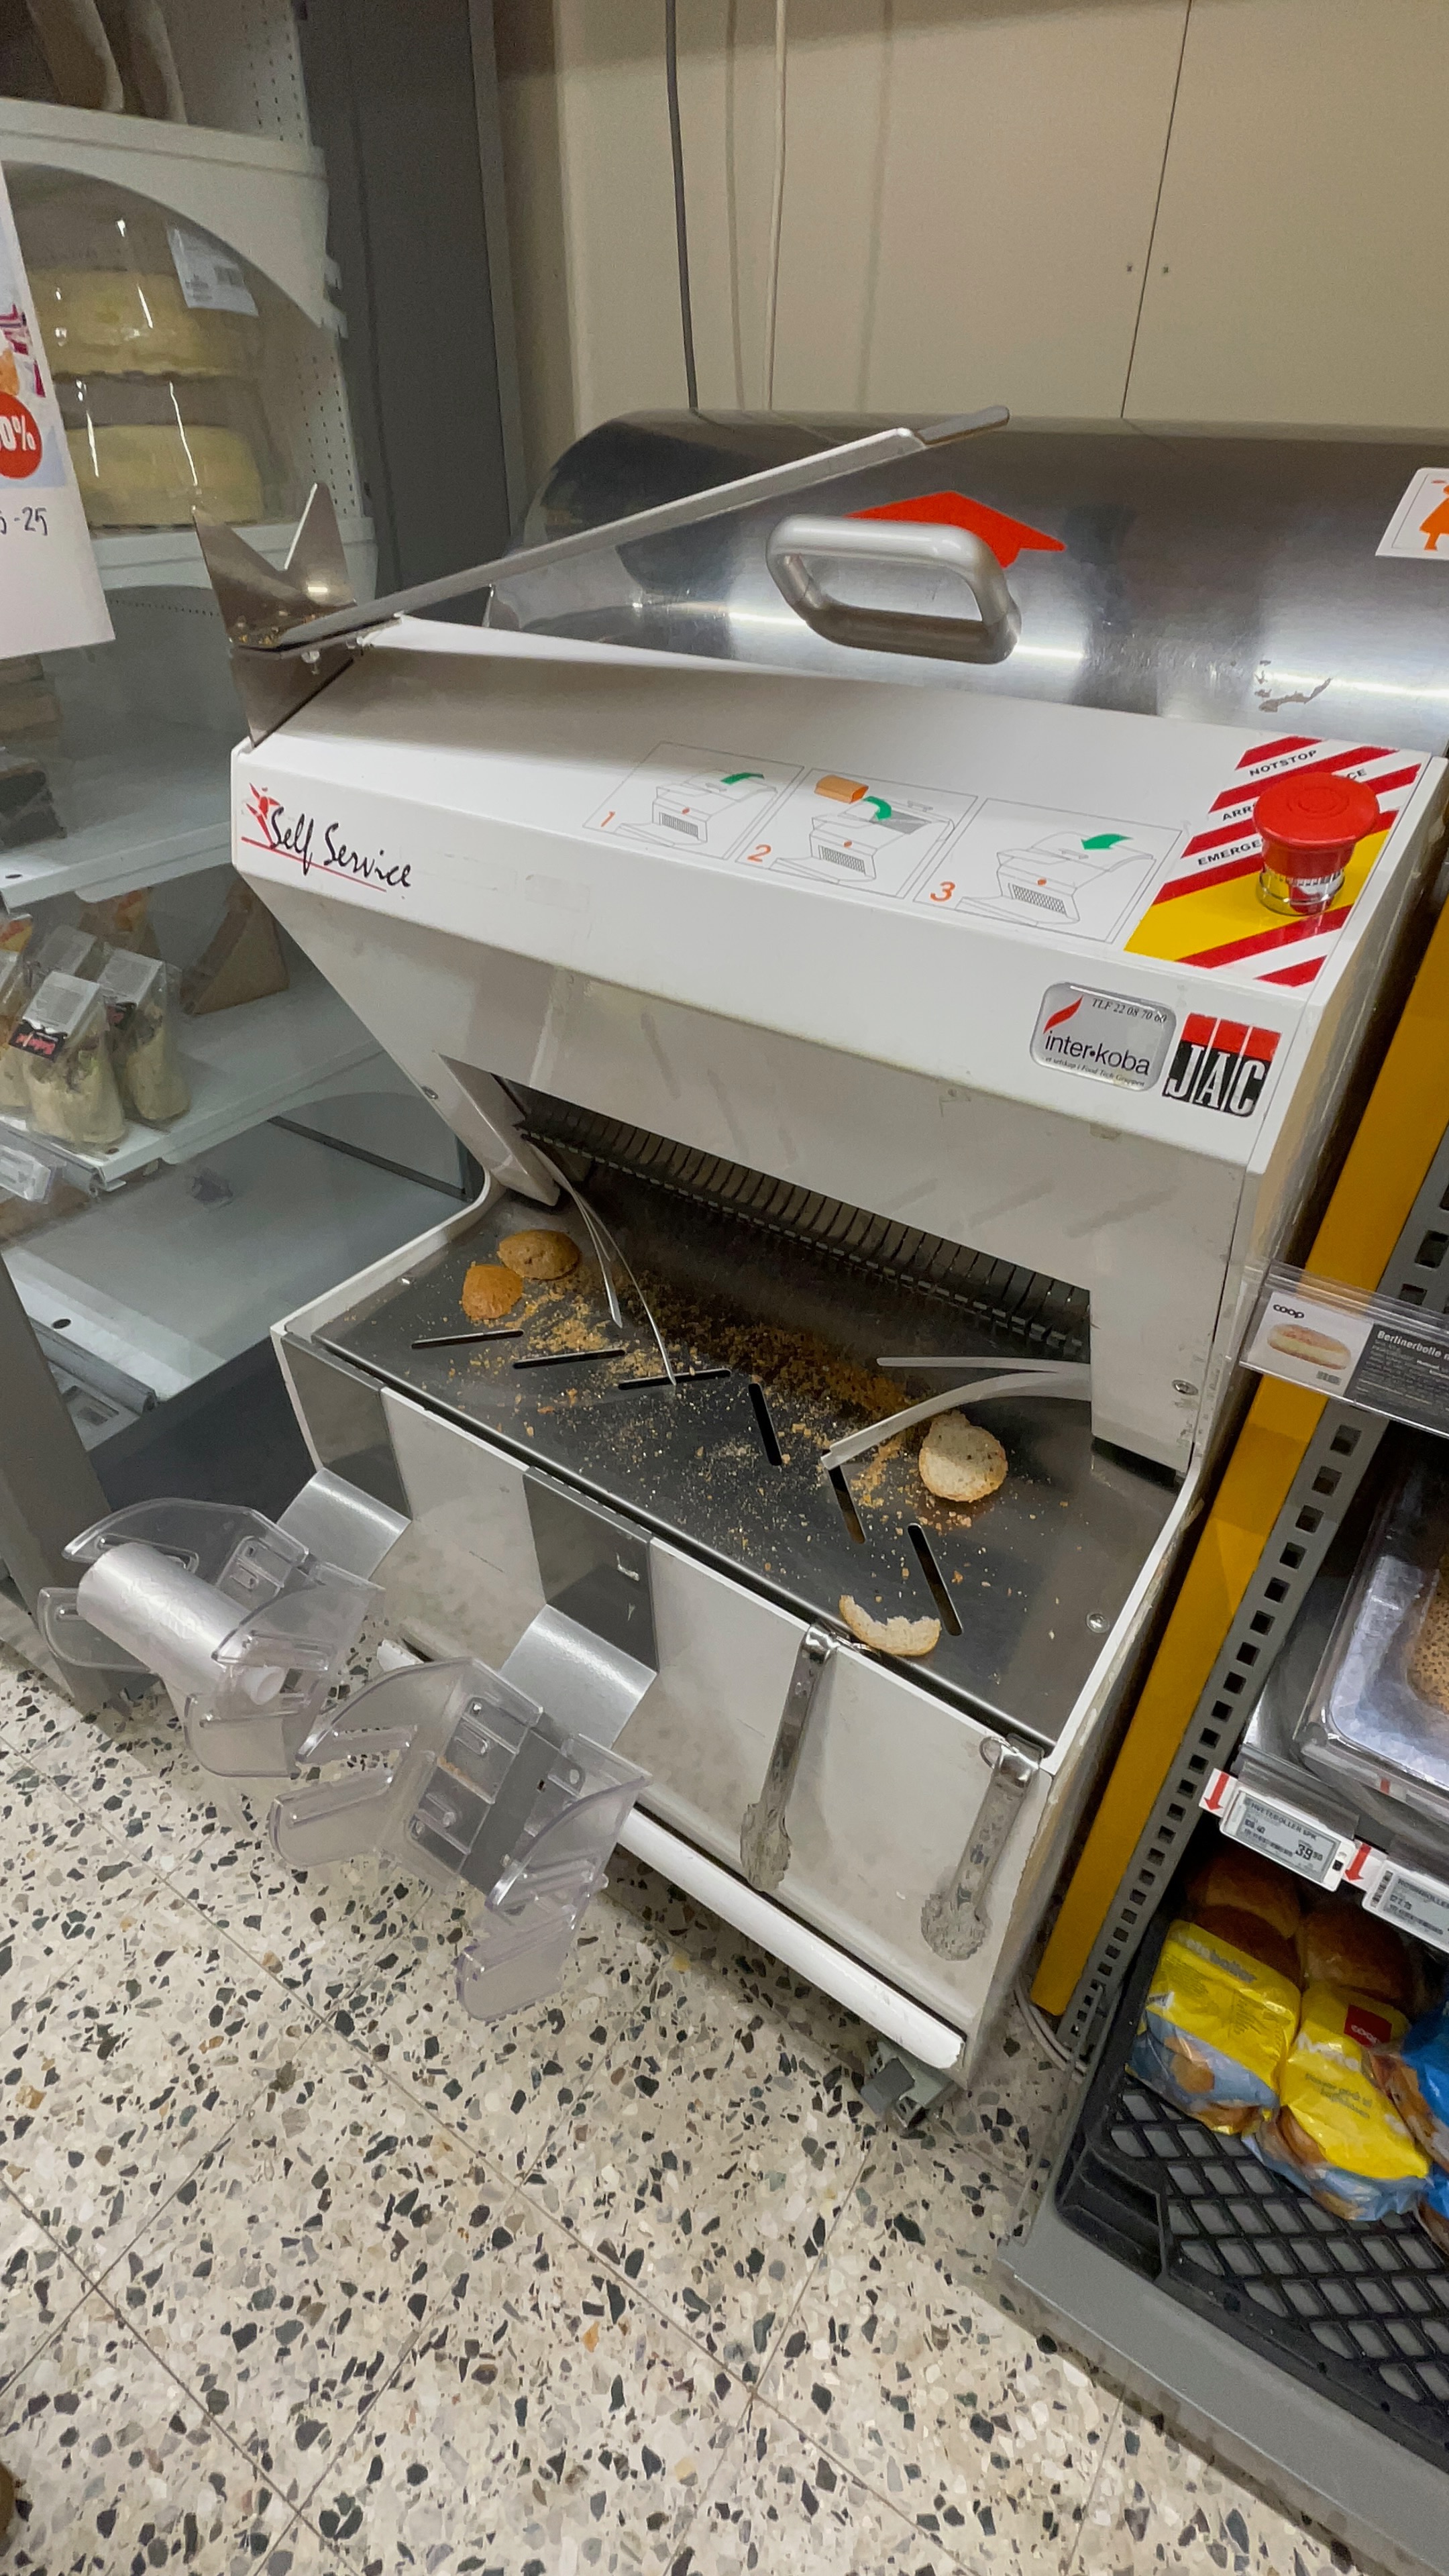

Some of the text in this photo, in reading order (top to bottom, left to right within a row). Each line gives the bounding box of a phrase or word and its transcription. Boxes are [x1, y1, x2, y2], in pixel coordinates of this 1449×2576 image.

[0, 415, 36, 451] 0%
[1249, 749, 1318, 777] NOTSTOP
[600, 811, 616, 828] 1
[1222, 802, 1255, 822] ARR
[268, 806, 411, 888] Self Service
[747, 844, 772, 863] 2
[1197, 838, 1264, 866] EMERGE
[930, 881, 957, 902] 3
[1091, 997, 1167, 1024] TLF 22 08 70 60
[1081, 1064, 1098, 1074] Food
[1099, 1069, 1114, 1078] Tech
[1165, 1044, 1266, 1115] JAC
[1273, 1304, 1305, 1319] coop
[1377, 1330, 1443, 1358] Berlinerbolle
[1295, 1843, 1313, 1861] 39
